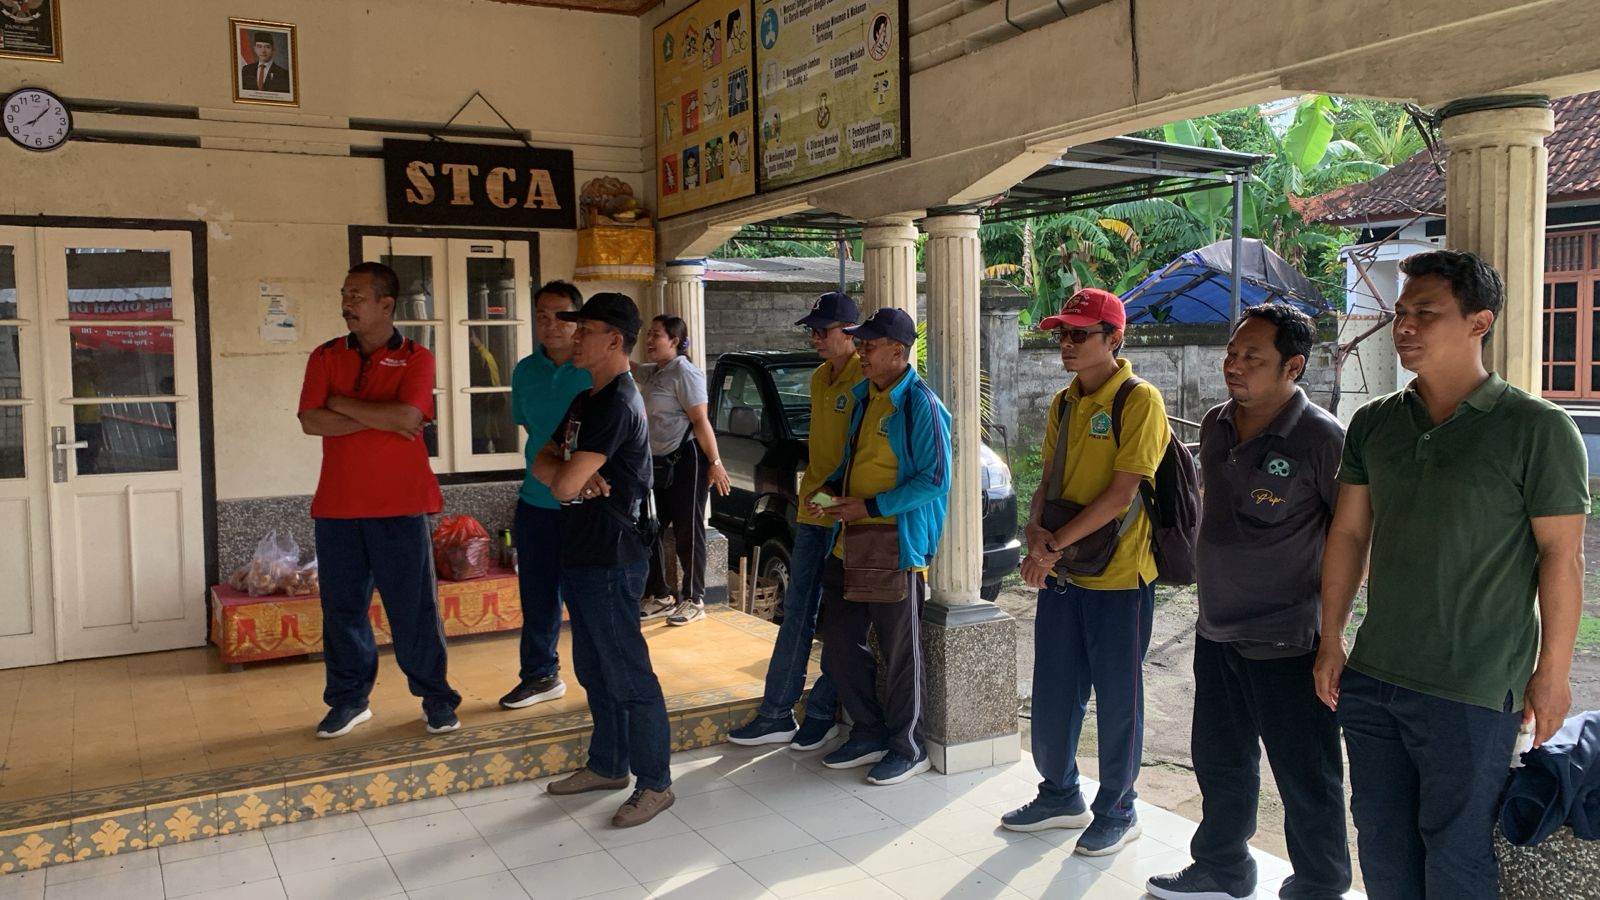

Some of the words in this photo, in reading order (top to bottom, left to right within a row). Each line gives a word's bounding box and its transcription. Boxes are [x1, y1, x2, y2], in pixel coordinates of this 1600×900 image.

[19, 96, 27, 105] 11
[30, 94, 40, 103] 12
[46, 98, 50, 106] 1
[11, 104, 20, 113] 10
[55, 107, 61, 115] 2
[7, 114, 14, 123] 9
[60, 118, 66, 126] 3
[13, 125, 20, 134] 8
[57, 128, 63, 136] 4
[23, 134, 30, 143] 7
[35, 137, 42, 146] 6
[48, 136, 55, 144] 5
[405, 160, 561, 210] STCA
